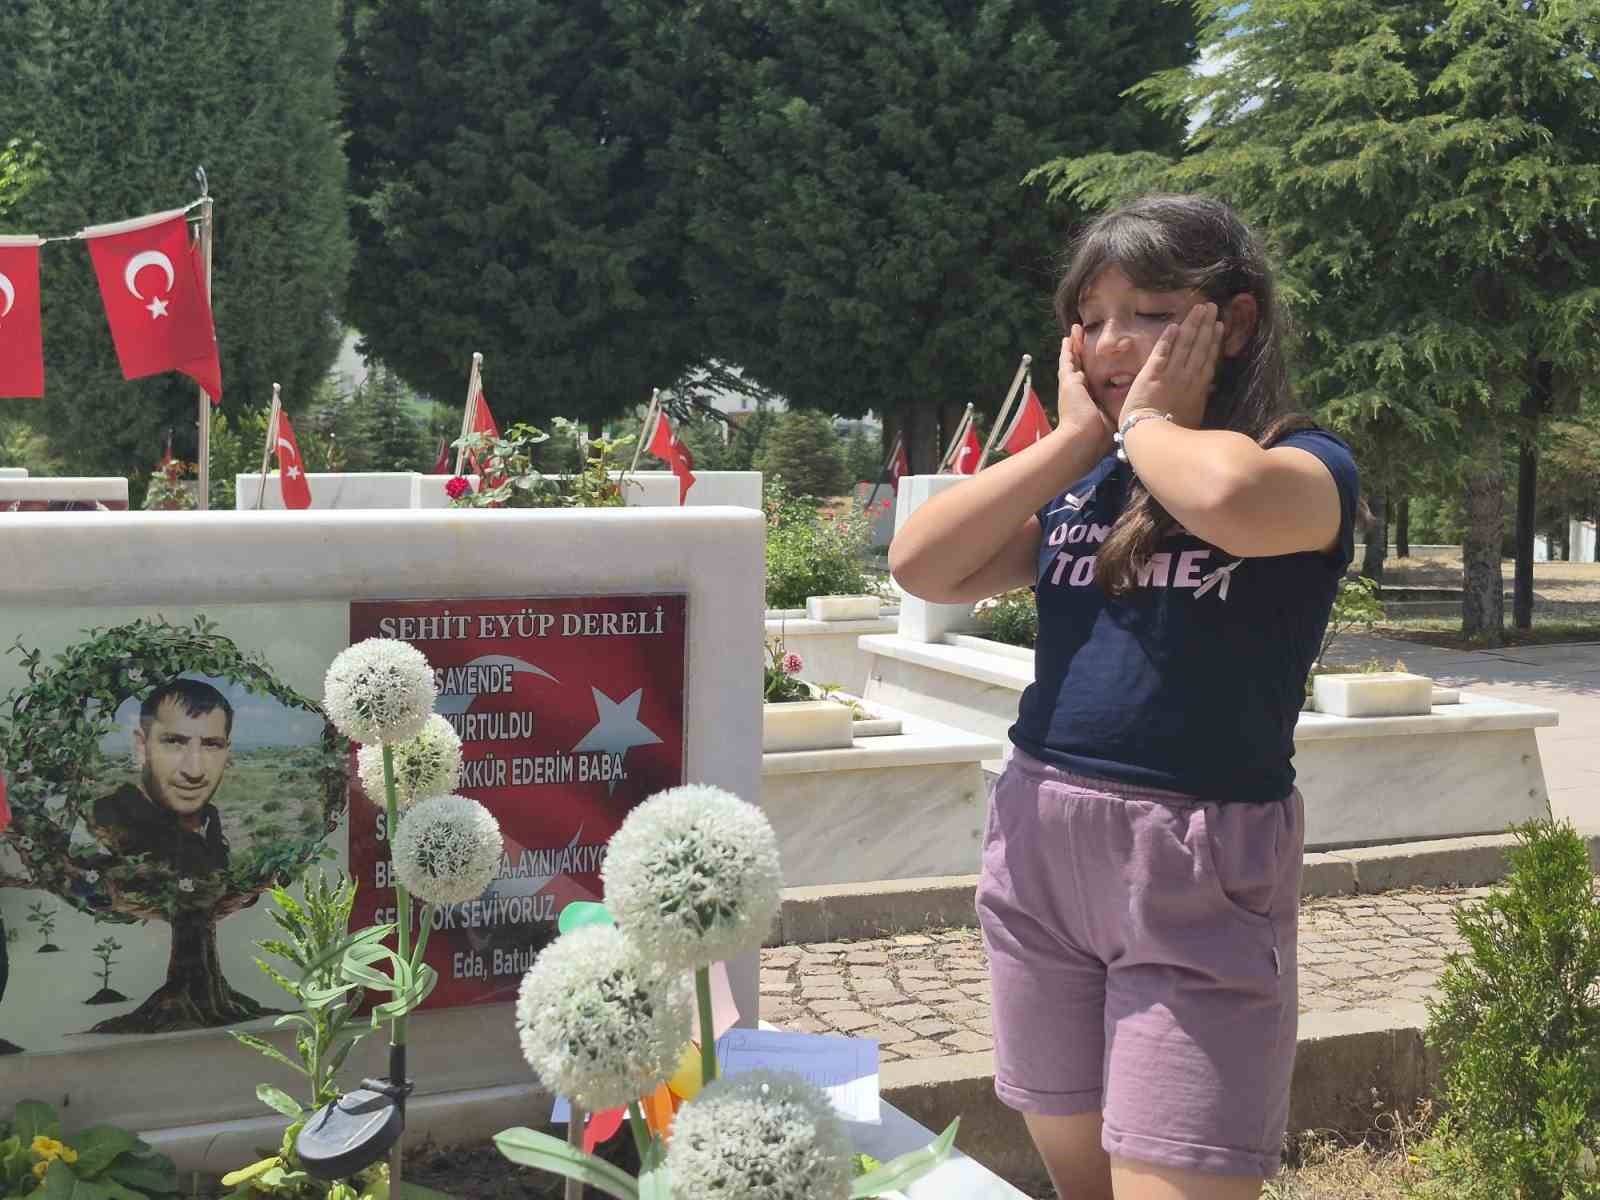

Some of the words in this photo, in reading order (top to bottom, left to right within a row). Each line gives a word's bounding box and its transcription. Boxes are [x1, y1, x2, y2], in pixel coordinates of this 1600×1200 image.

[1049, 522, 1110, 546] DON
[1050, 551, 1098, 587] TO
[1136, 550, 1211, 588] ME
[478, 609, 555, 638] EYÜP
[561, 605, 665, 636] DERELİ
[457, 753, 507, 789] KKÜR
[511, 751, 574, 786] EDERİM
[578, 753, 629, 783] BABA.
[519, 848, 556, 878] AYNI
[560, 844, 608, 874] AKIYO
[453, 950, 488, 982] Eda,
[493, 944, 539, 975] Batuh
